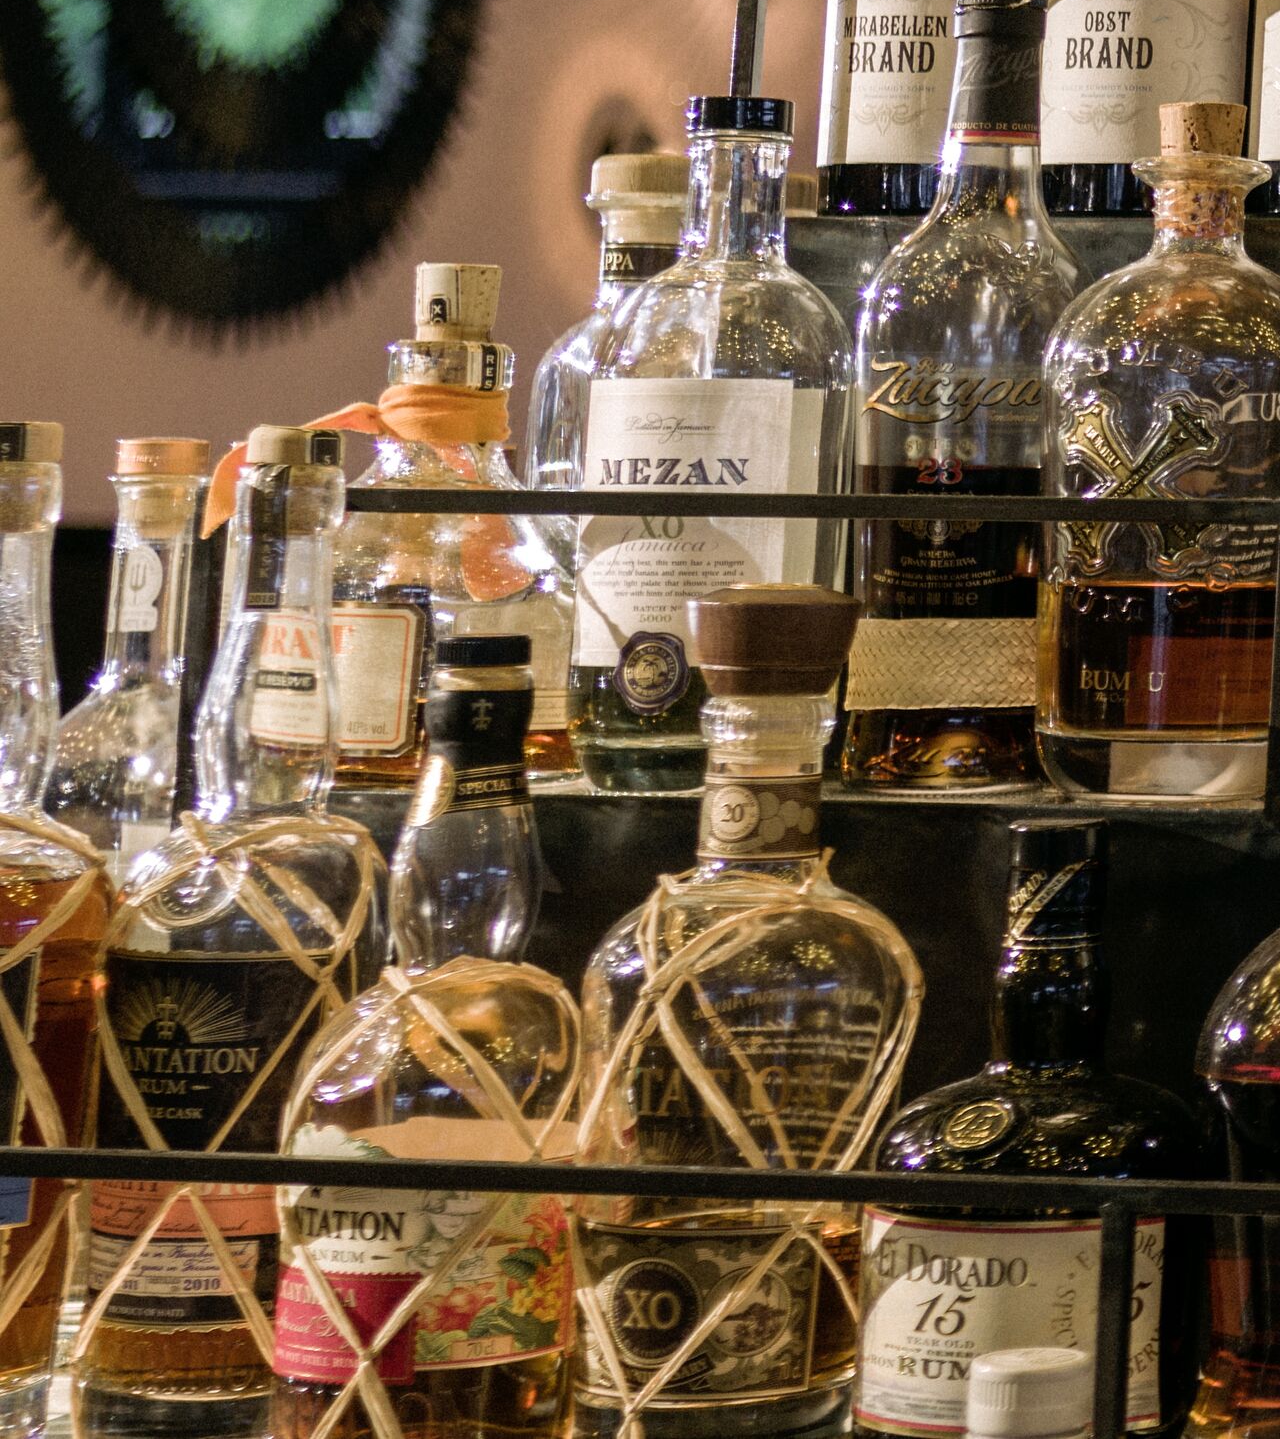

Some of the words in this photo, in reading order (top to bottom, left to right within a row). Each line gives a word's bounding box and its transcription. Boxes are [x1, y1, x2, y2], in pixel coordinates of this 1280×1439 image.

[844, 15, 948, 38] MIRABELLEN
[1085, 11, 1131, 32] OBST
[848, 40, 935, 74] BRAND
[1065, 37, 1153, 70] BRAND
[995, 122, 1009, 131] DE
[861, 355, 1042, 425] Zacapa
[599, 458, 750, 486] MEZAN
[917, 457, 964, 485] 23
[633, 605, 666, 613] BATCH
[1081, 668, 1166, 692] BUMU
[719, 803, 745, 823] 20
[330, 1250, 366, 1264] RUM
[877, 1238, 898, 1280] EL
[906, 1243, 1029, 1292] DORADO
[182, 1276, 222, 1292] 2010
[622, 1289, 682, 1331] XO
[913, 1293, 976, 1337] 15
[943, 1337, 976, 1350] OLD
[897, 1356, 972, 1381] RUM
